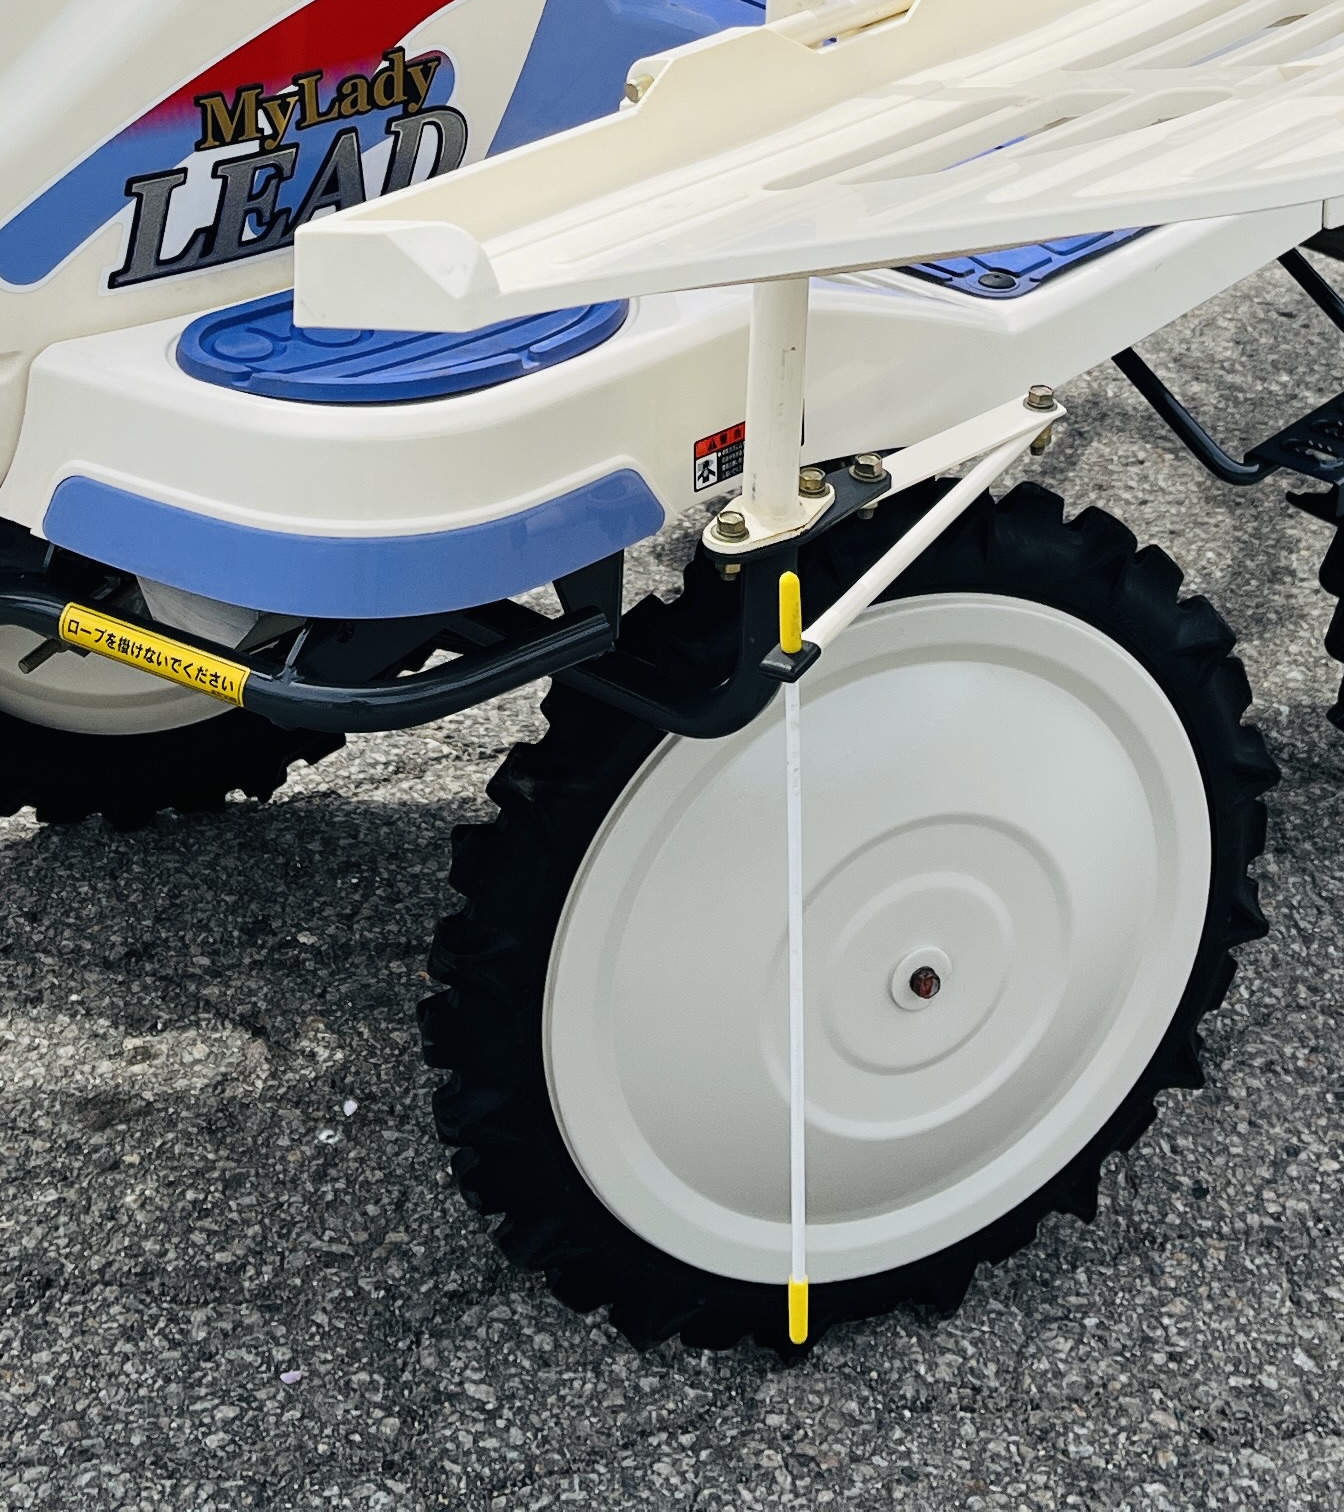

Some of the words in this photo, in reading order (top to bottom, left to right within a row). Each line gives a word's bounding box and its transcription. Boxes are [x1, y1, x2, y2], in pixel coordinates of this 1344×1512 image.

[195, 46, 442, 152] MyLady
[67, 619, 235, 692] ロープを掛けないでください
